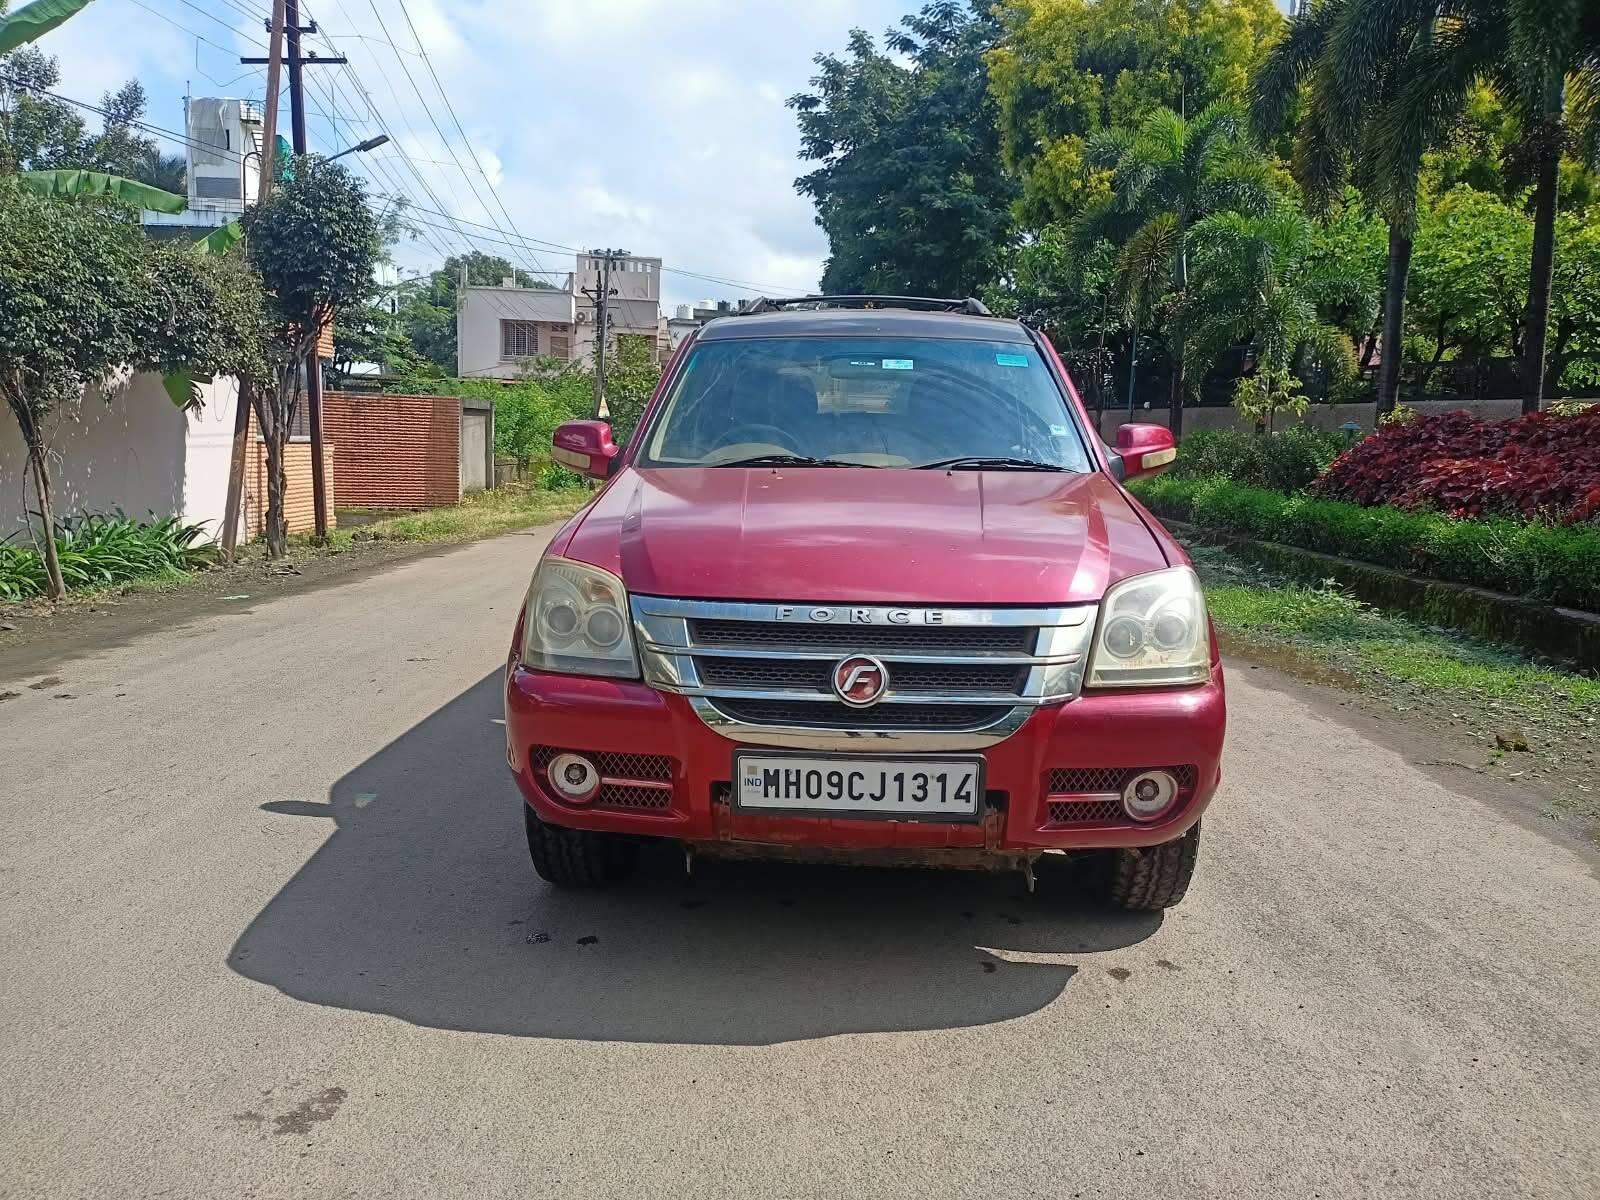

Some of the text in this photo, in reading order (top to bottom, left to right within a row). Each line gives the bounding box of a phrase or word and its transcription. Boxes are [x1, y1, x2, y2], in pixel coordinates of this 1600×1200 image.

[776, 606, 943, 624] FORCE
[743, 777, 762, 787] IND
[763, 768, 973, 803] MH09CJ1314
